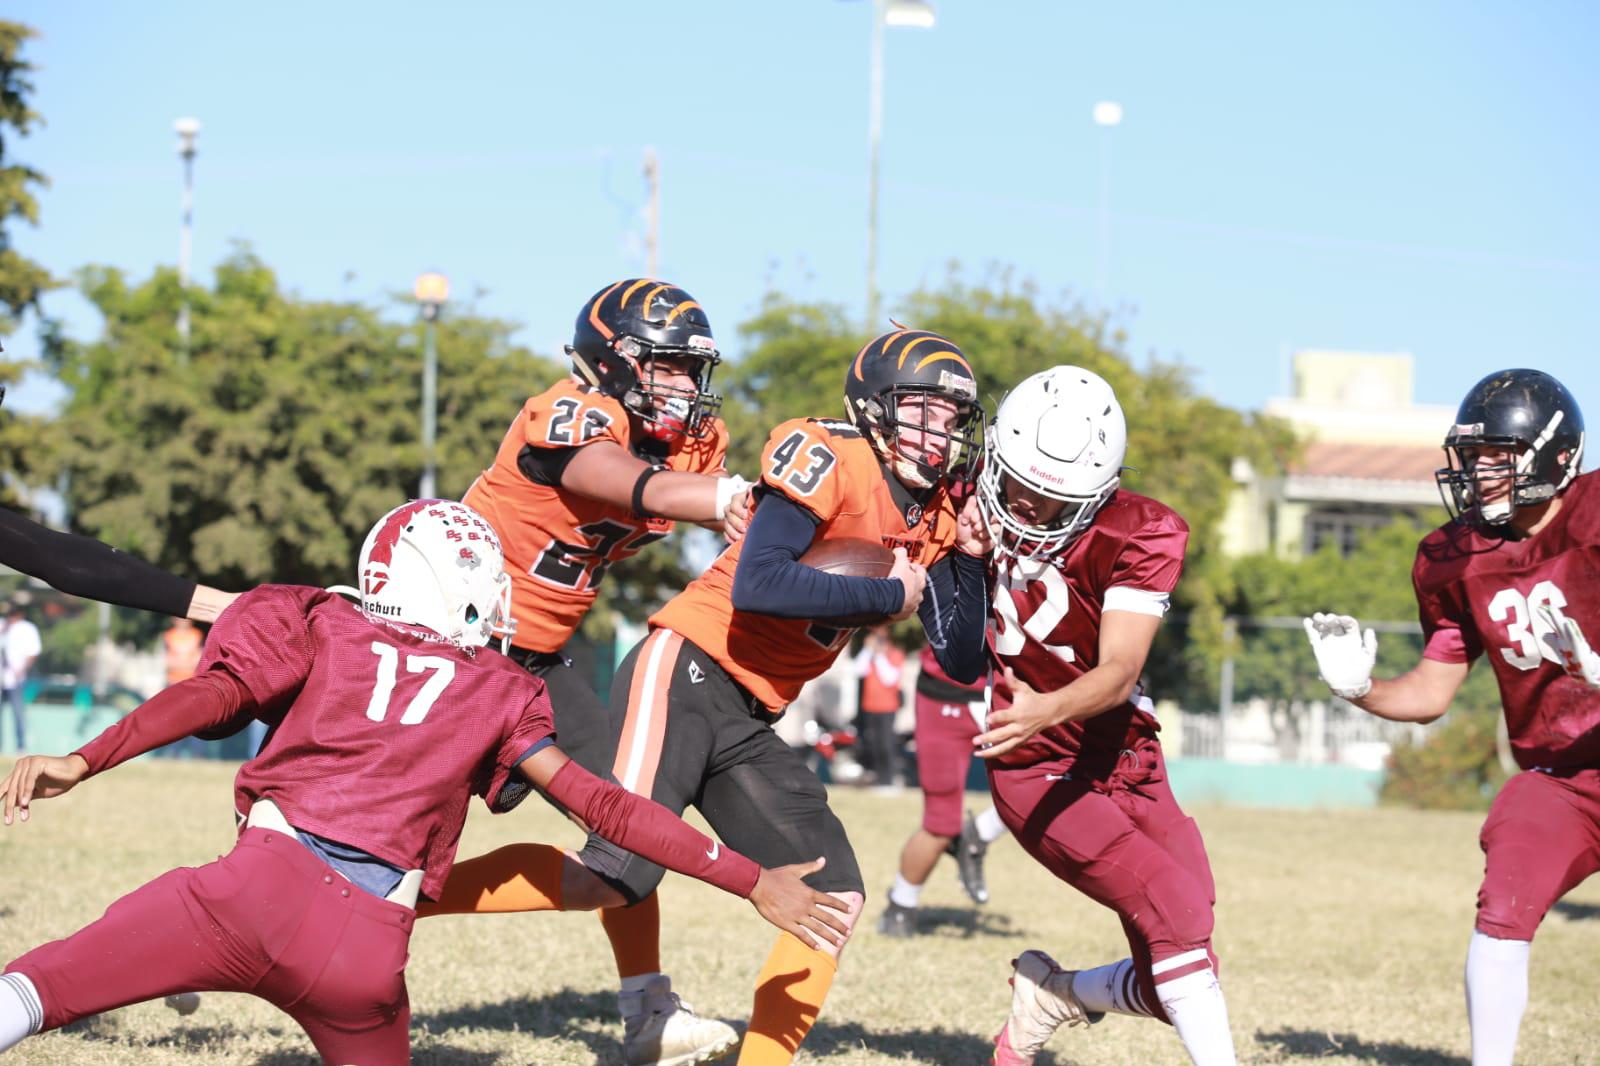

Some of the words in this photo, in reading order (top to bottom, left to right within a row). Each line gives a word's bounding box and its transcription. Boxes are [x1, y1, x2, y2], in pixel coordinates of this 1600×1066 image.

[768, 429, 837, 497] 43
[1029, 465, 1065, 486] Riddell
[453, 515, 469, 527] BS
[446, 529, 463, 543] BS
[364, 569, 390, 595] 17
[364, 601, 402, 616] schutt
[366, 641, 456, 725] 17
